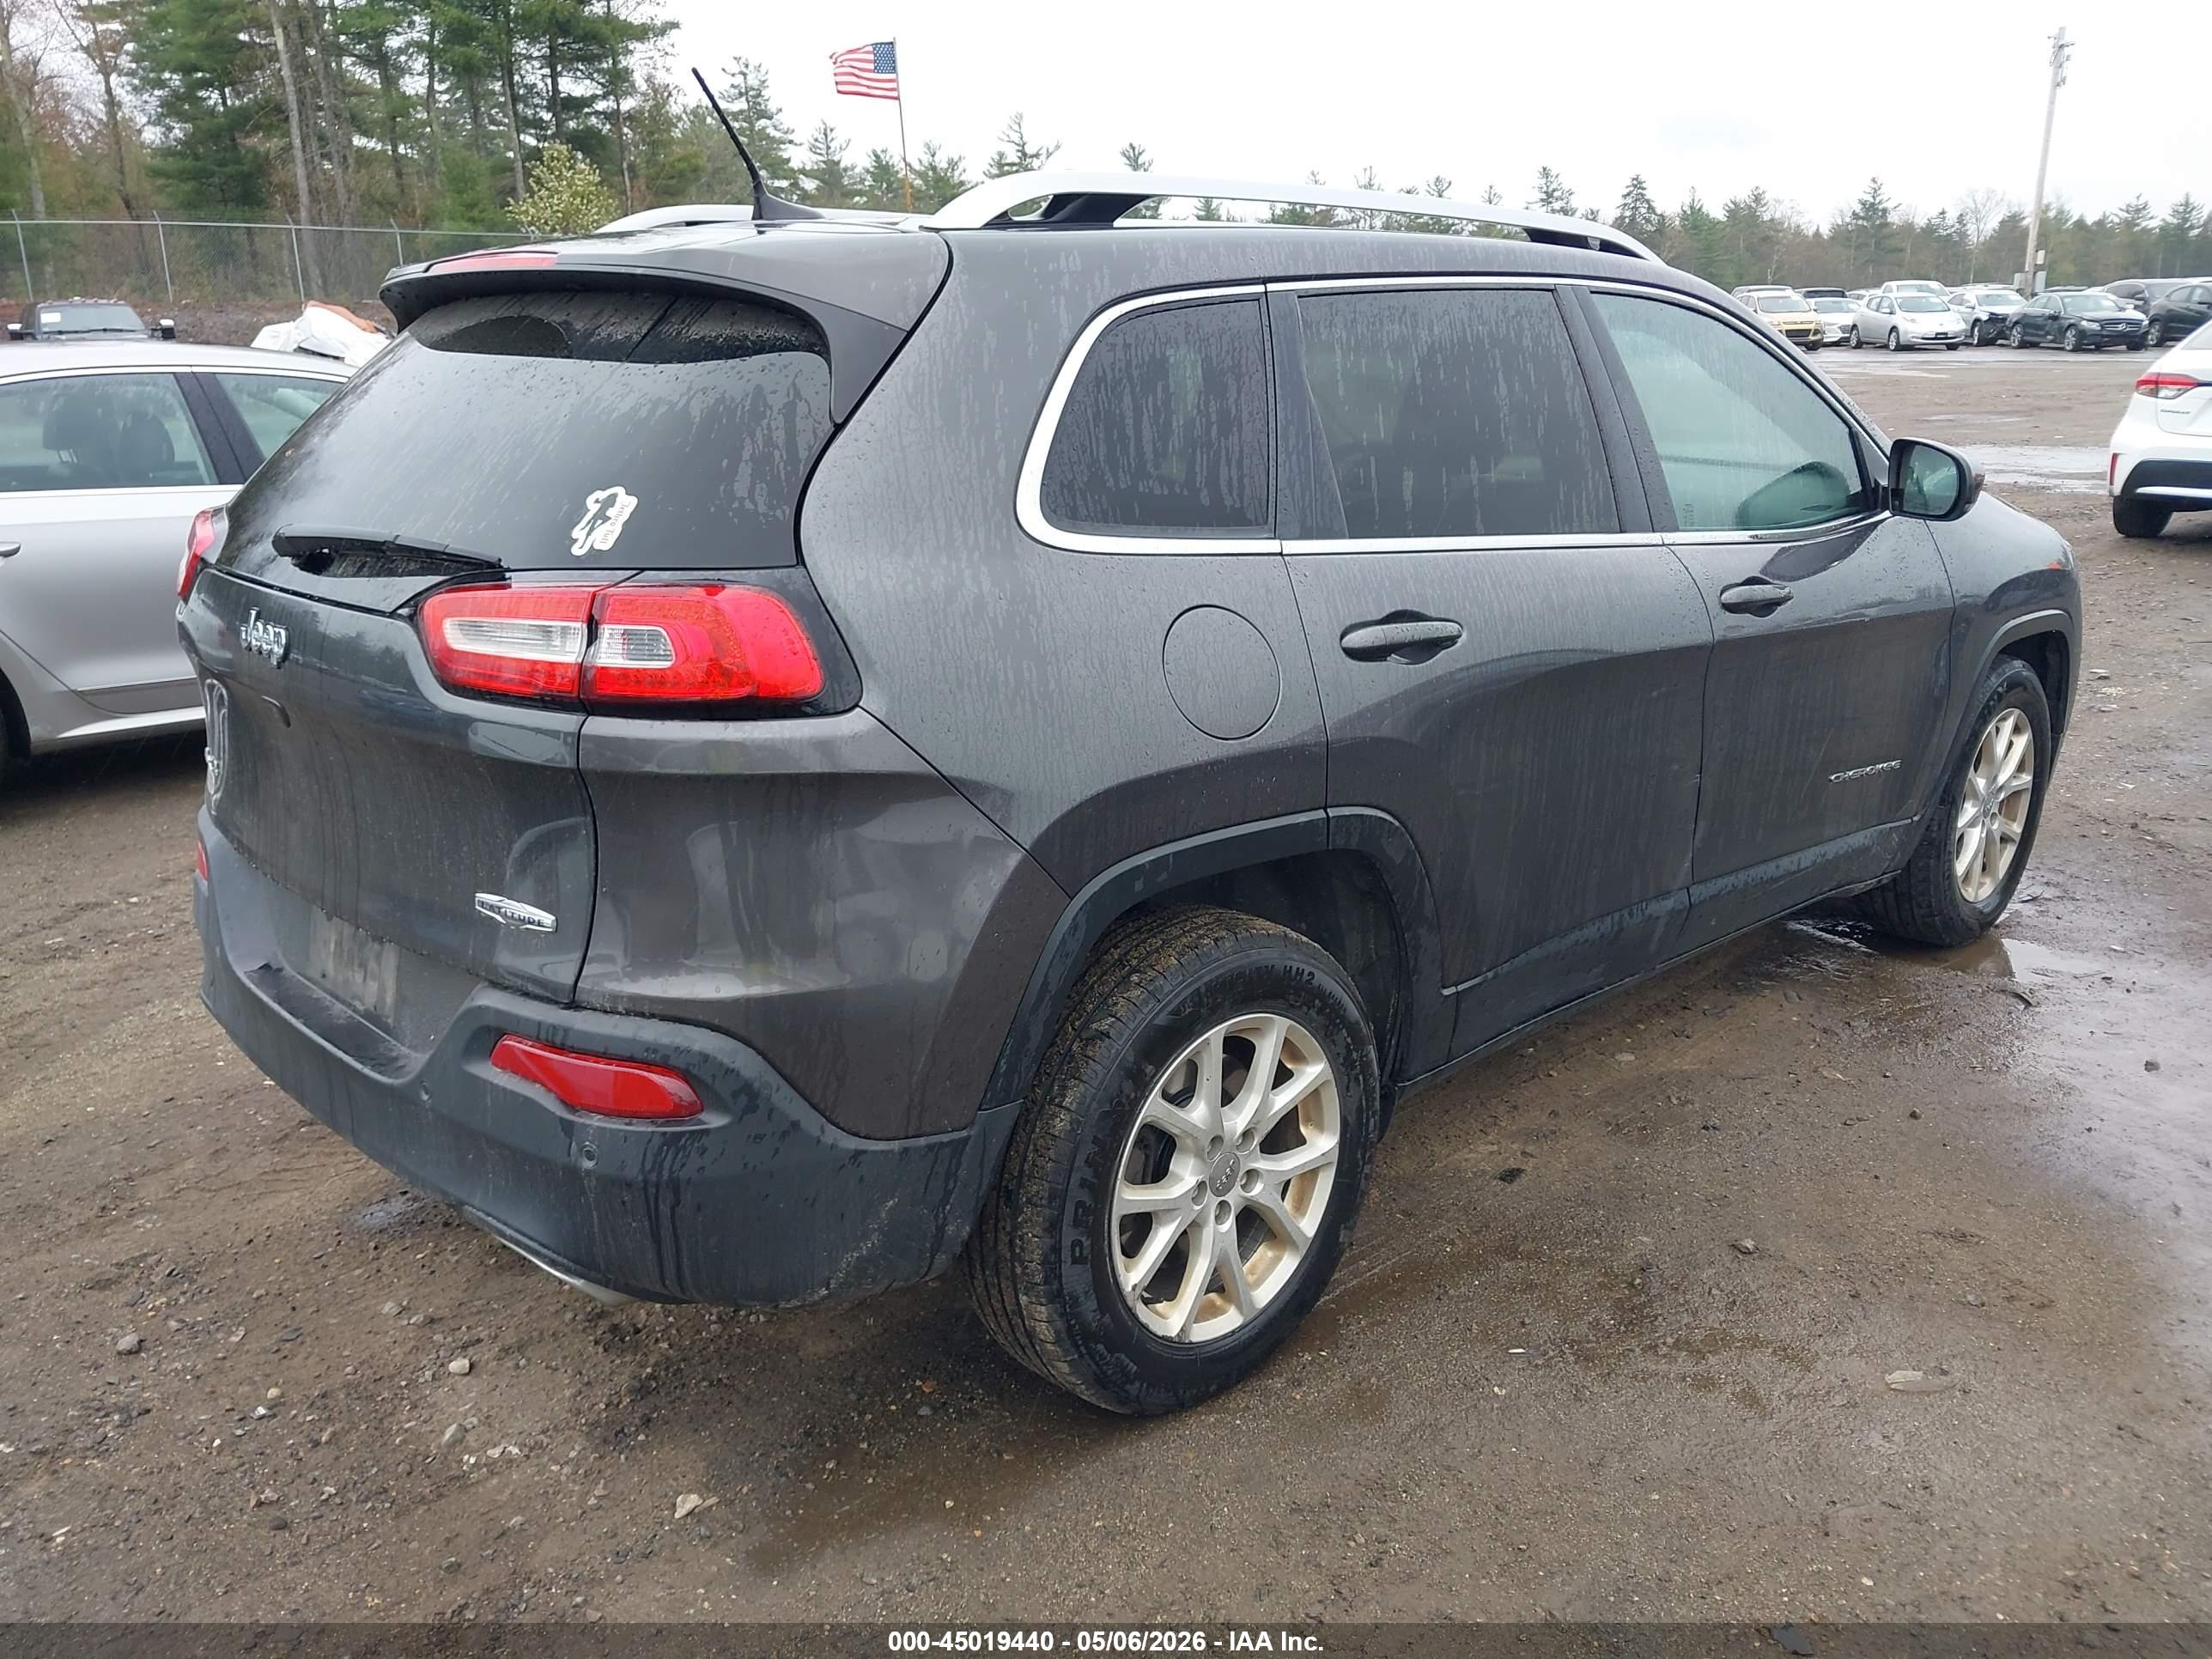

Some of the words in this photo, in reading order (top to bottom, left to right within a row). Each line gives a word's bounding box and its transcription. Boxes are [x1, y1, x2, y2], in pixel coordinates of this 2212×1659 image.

[240, 607, 288, 666] Jeep
[1828, 759, 1902, 783] CHEROKEE
[478, 899, 545, 927] LATITUDE
